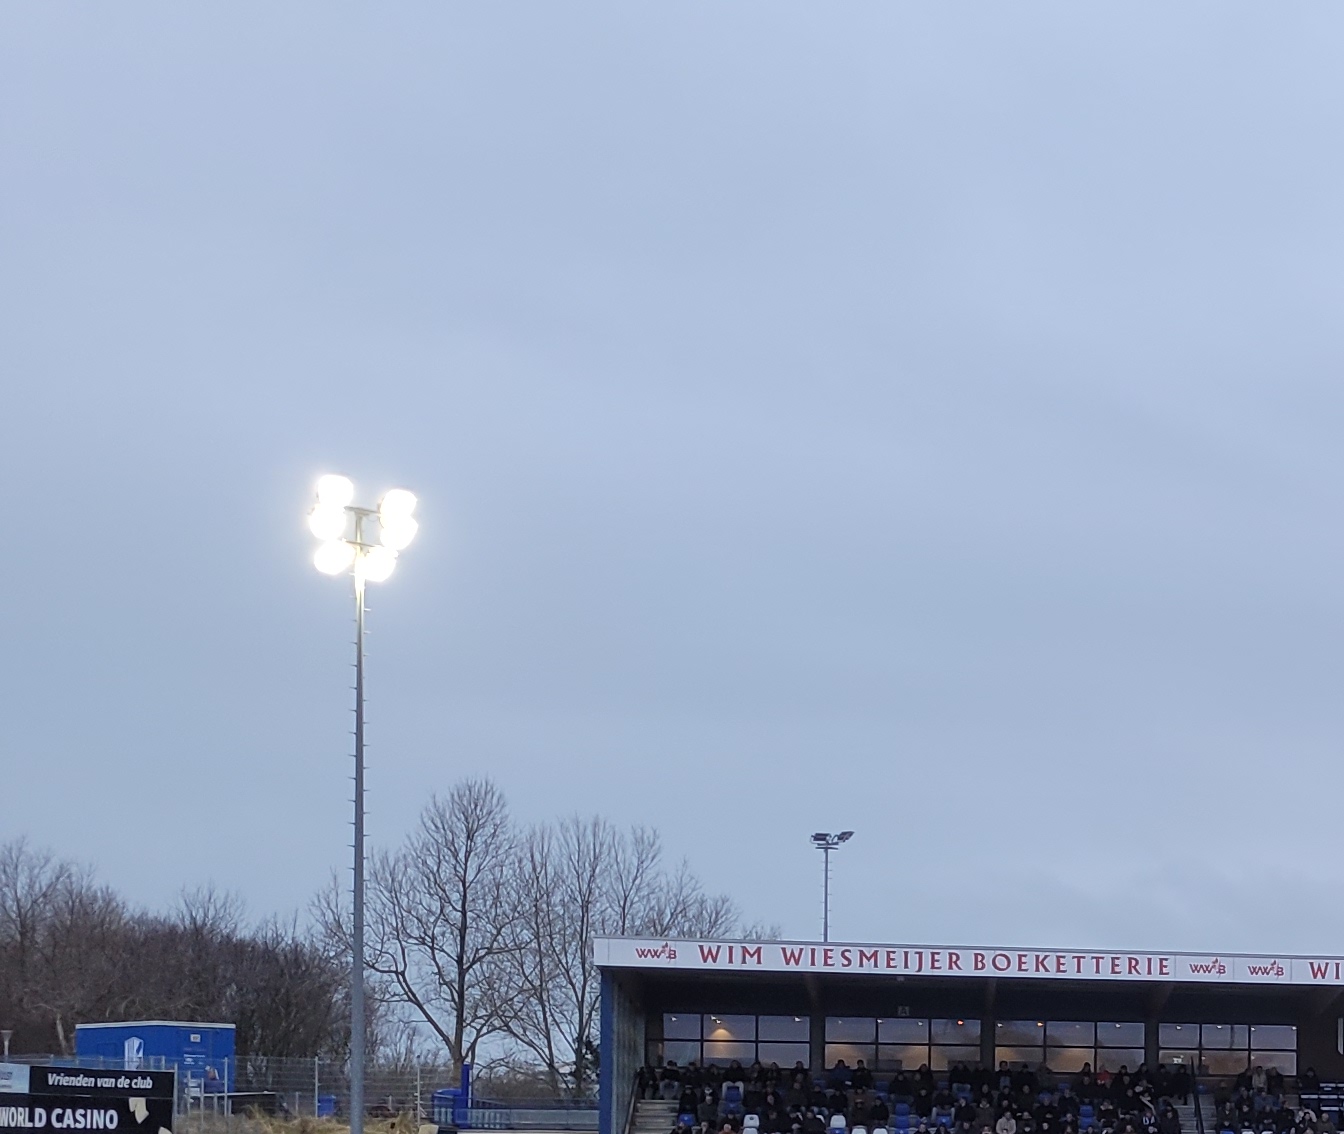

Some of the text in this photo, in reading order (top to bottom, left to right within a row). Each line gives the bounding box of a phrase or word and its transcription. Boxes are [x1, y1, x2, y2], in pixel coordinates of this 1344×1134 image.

[698, 944, 1170, 976] WIM WIESMEIJER BOEKETTERIE
[47, 1073, 153, 1089] Vrienden van de club
[51, 1108, 119, 1130] CASINO
